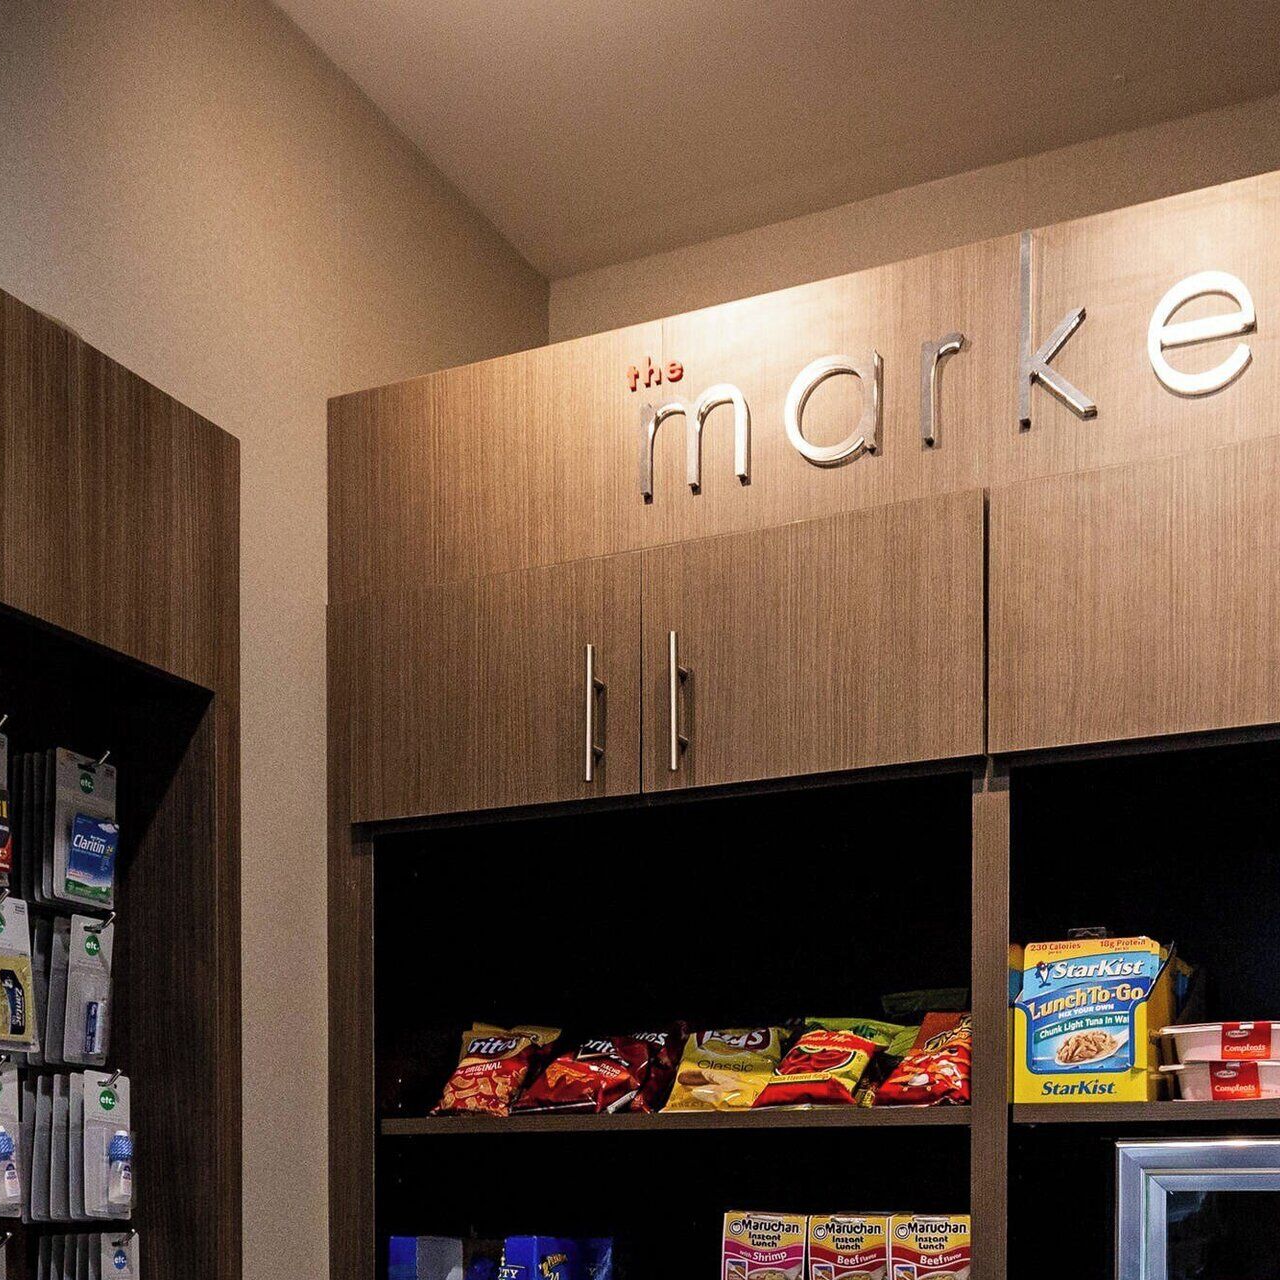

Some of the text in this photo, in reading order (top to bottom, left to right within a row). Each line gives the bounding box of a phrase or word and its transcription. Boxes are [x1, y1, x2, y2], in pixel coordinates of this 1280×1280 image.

[626, 356, 684, 393] the
[73, 833, 105, 855] Claritin
[1049, 942, 1081, 950] Calories
[1116, 939, 1146, 947] Protein
[1052, 957, 1145, 980] StarKist
[1027, 987, 1088, 1020] Lunch
[1073, 1006, 1094, 1017] YOUR
[1096, 1003, 1114, 1012] OWN
[1039, 1016, 1103, 1039] Chunk Light Tuna
[1224, 1043, 1266, 1052] Compleats
[697, 1058, 754, 1073] Classic
[1041, 1079, 1117, 1096] StarKist
[1214, 1084, 1255, 1093] Compleats
[742, 1219, 799, 1234] Maruchan
[825, 1221, 881, 1235] Maruchan
[907, 1221, 967, 1235] Maruchan
[748, 1232, 781, 1241] Instant
[832, 1235, 865, 1243] Instant
[915, 1235, 948, 1243] Instant
[751, 1240, 777, 1248] Lunch
[835, 1242, 861, 1250] Lunch
[918, 1242, 945, 1250] Lunch
[753, 1248, 787, 1262] Shrimp
[837, 1254, 859, 1265] Beef
[920, 1254, 943, 1265] Beef
